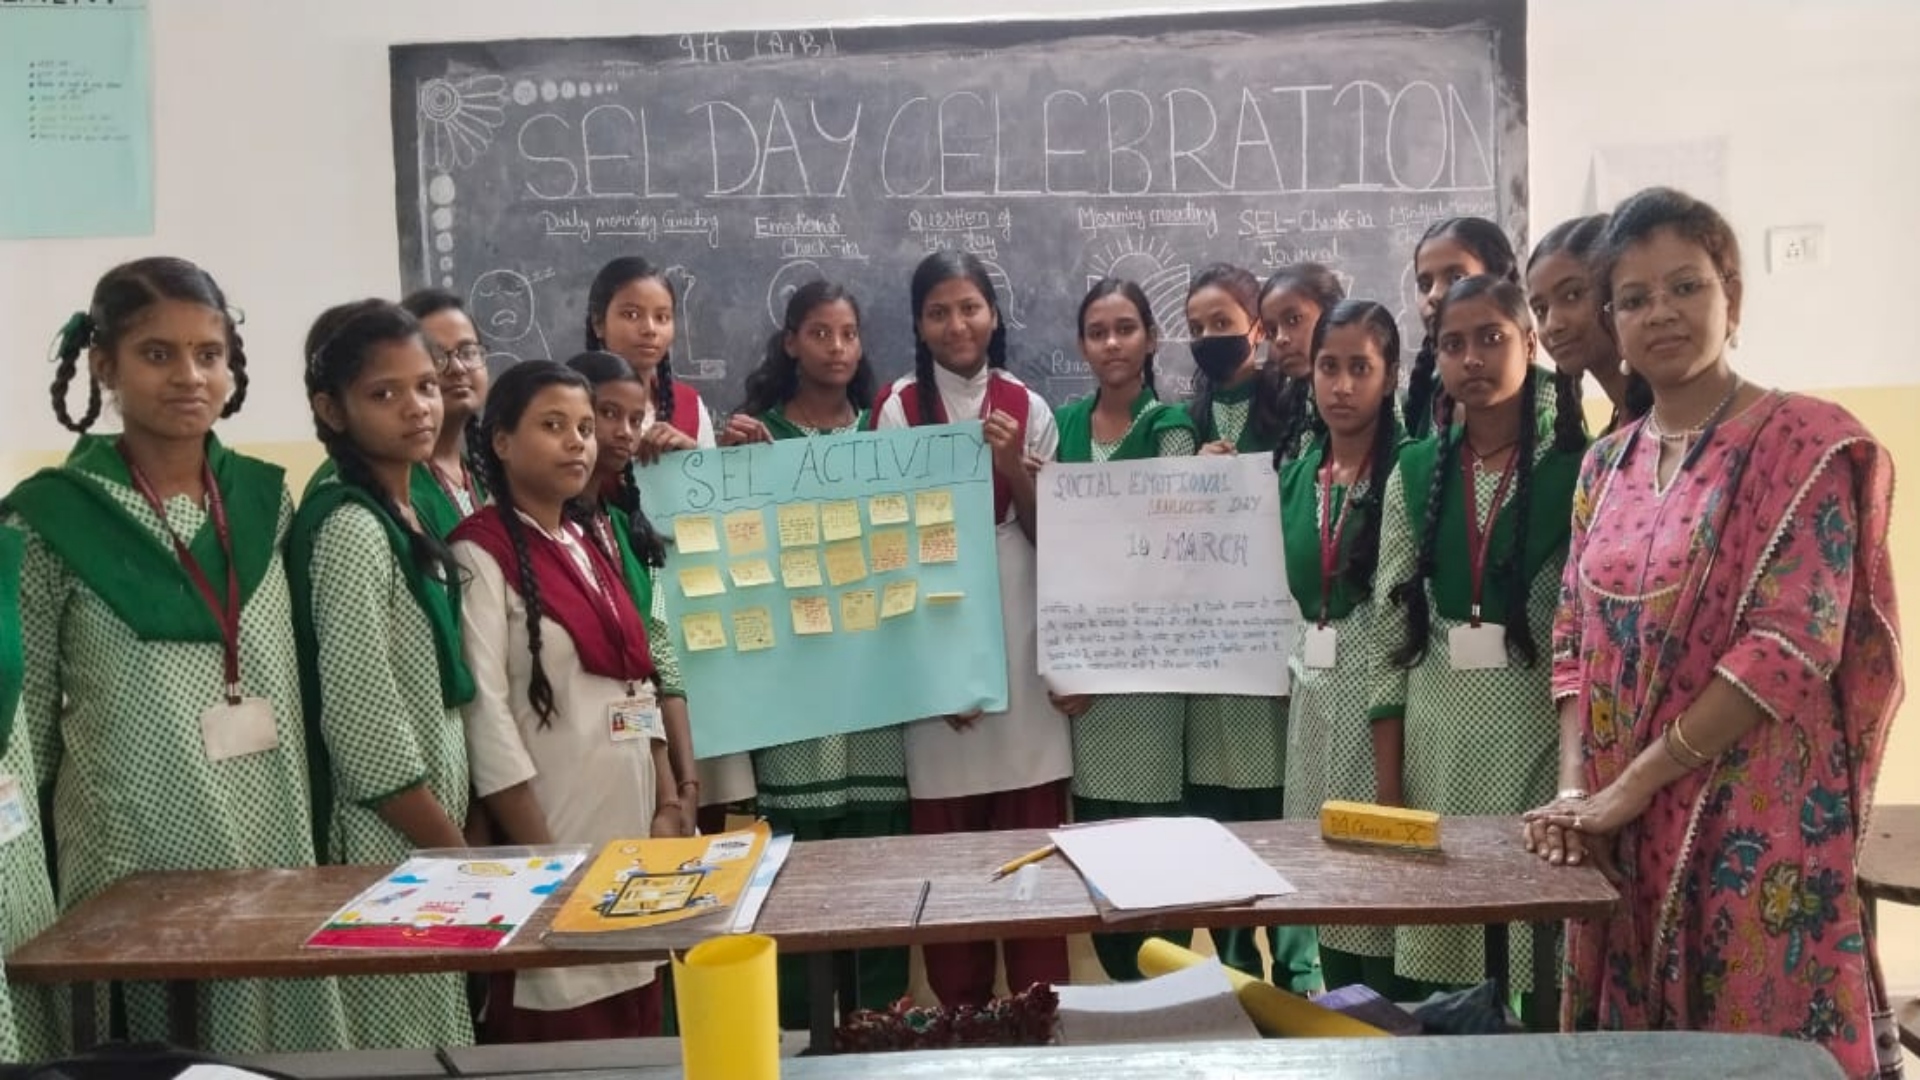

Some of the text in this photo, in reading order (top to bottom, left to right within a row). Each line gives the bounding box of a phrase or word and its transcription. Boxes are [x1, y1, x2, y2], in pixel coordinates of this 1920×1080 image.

[518, 80, 1496, 200] SEL DAY CELEBRATION
[540, 208, 590, 243] Daily
[1078, 205, 1146, 236] Morning
[681, 433, 987, 509] SEL ACTIVITY
[1054, 471, 1233, 499] SOCIAL EMOTIONAL
[1161, 530, 1249, 566] MARCH
